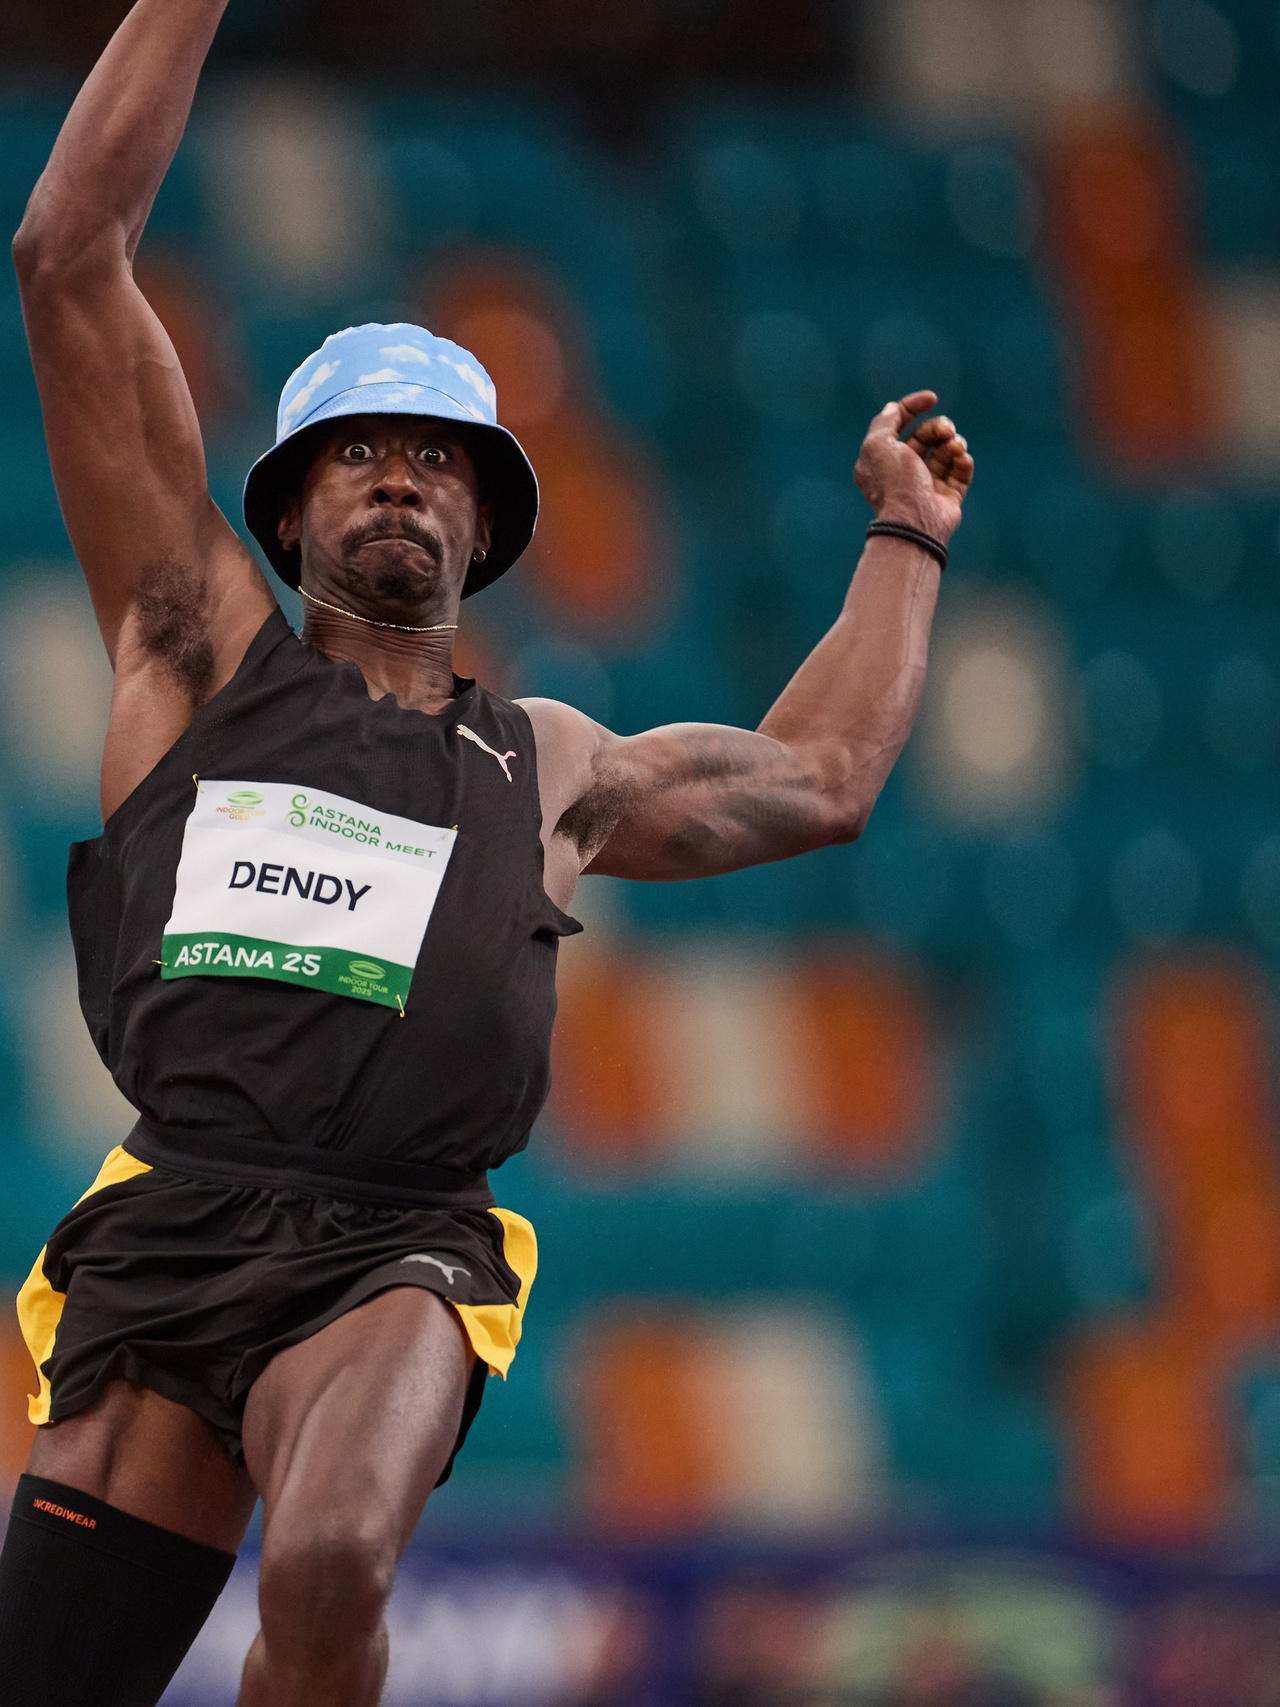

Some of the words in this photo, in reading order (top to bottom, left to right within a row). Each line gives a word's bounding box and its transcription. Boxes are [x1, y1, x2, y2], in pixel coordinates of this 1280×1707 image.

[309, 816, 380, 847] INDOOR
[385, 841, 437, 858] MEET
[312, 805, 382, 836] ASTANA
[228, 861, 372, 911] DENDY
[174, 942, 274, 968] ASTANA
[281, 952, 322, 977] 25
[338, 976, 368, 988] INDOOR
[369, 983, 389, 994] TOUR
[33, 1498, 97, 1529] INCREDIWEAR
